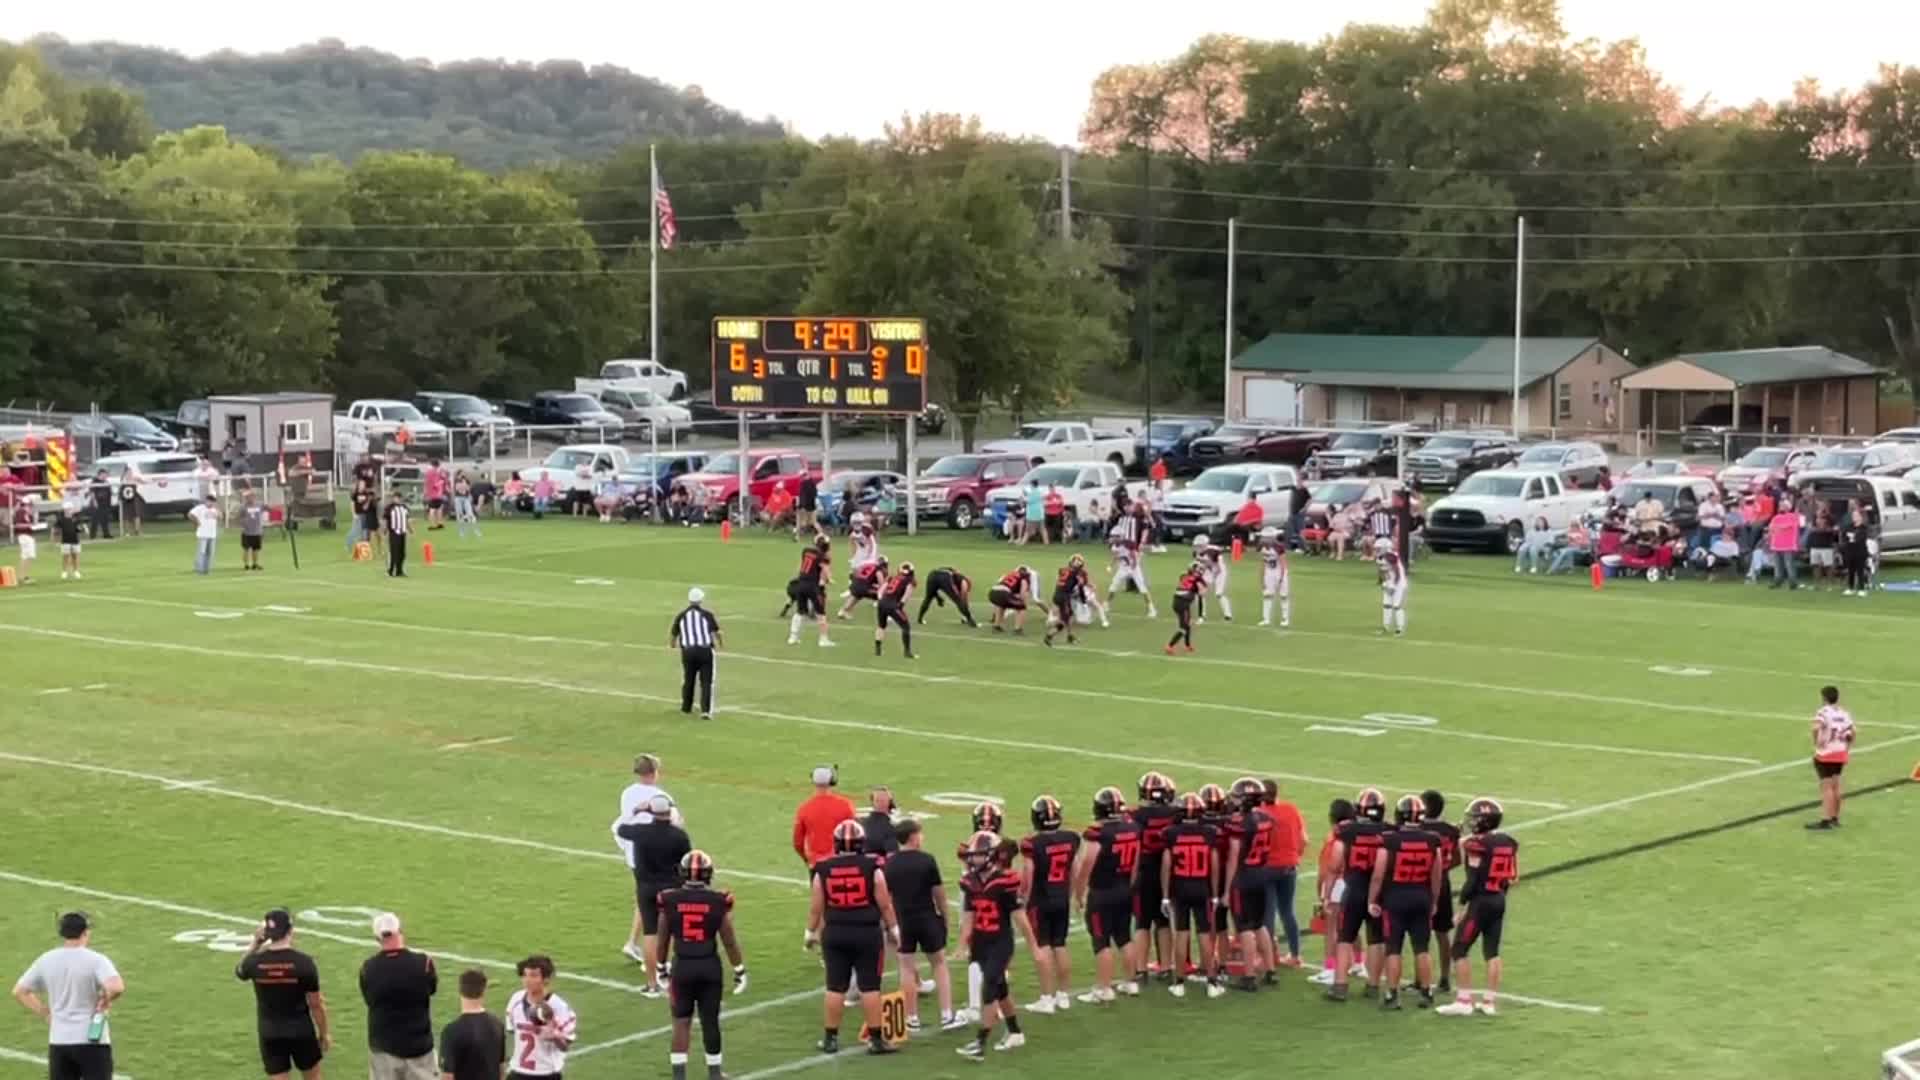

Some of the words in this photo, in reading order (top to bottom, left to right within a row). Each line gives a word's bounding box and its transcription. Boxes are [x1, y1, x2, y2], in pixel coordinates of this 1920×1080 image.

[717, 320, 759, 339] HOME
[794, 321, 857, 350] 9:29
[870, 322, 921, 340] VISITOR
[730, 343, 746, 372] 6
[752, 358, 765, 378] 3
[797, 359, 820, 375] QTR
[905, 345, 921, 374] 0
[872, 359, 887, 380] 3
[731, 385, 763, 402] DOWN
[806, 386, 820, 404] TO
[1173, 845, 1209, 877] 30
[683, 914, 704, 941] 5
[883, 998, 904, 1040] 30
